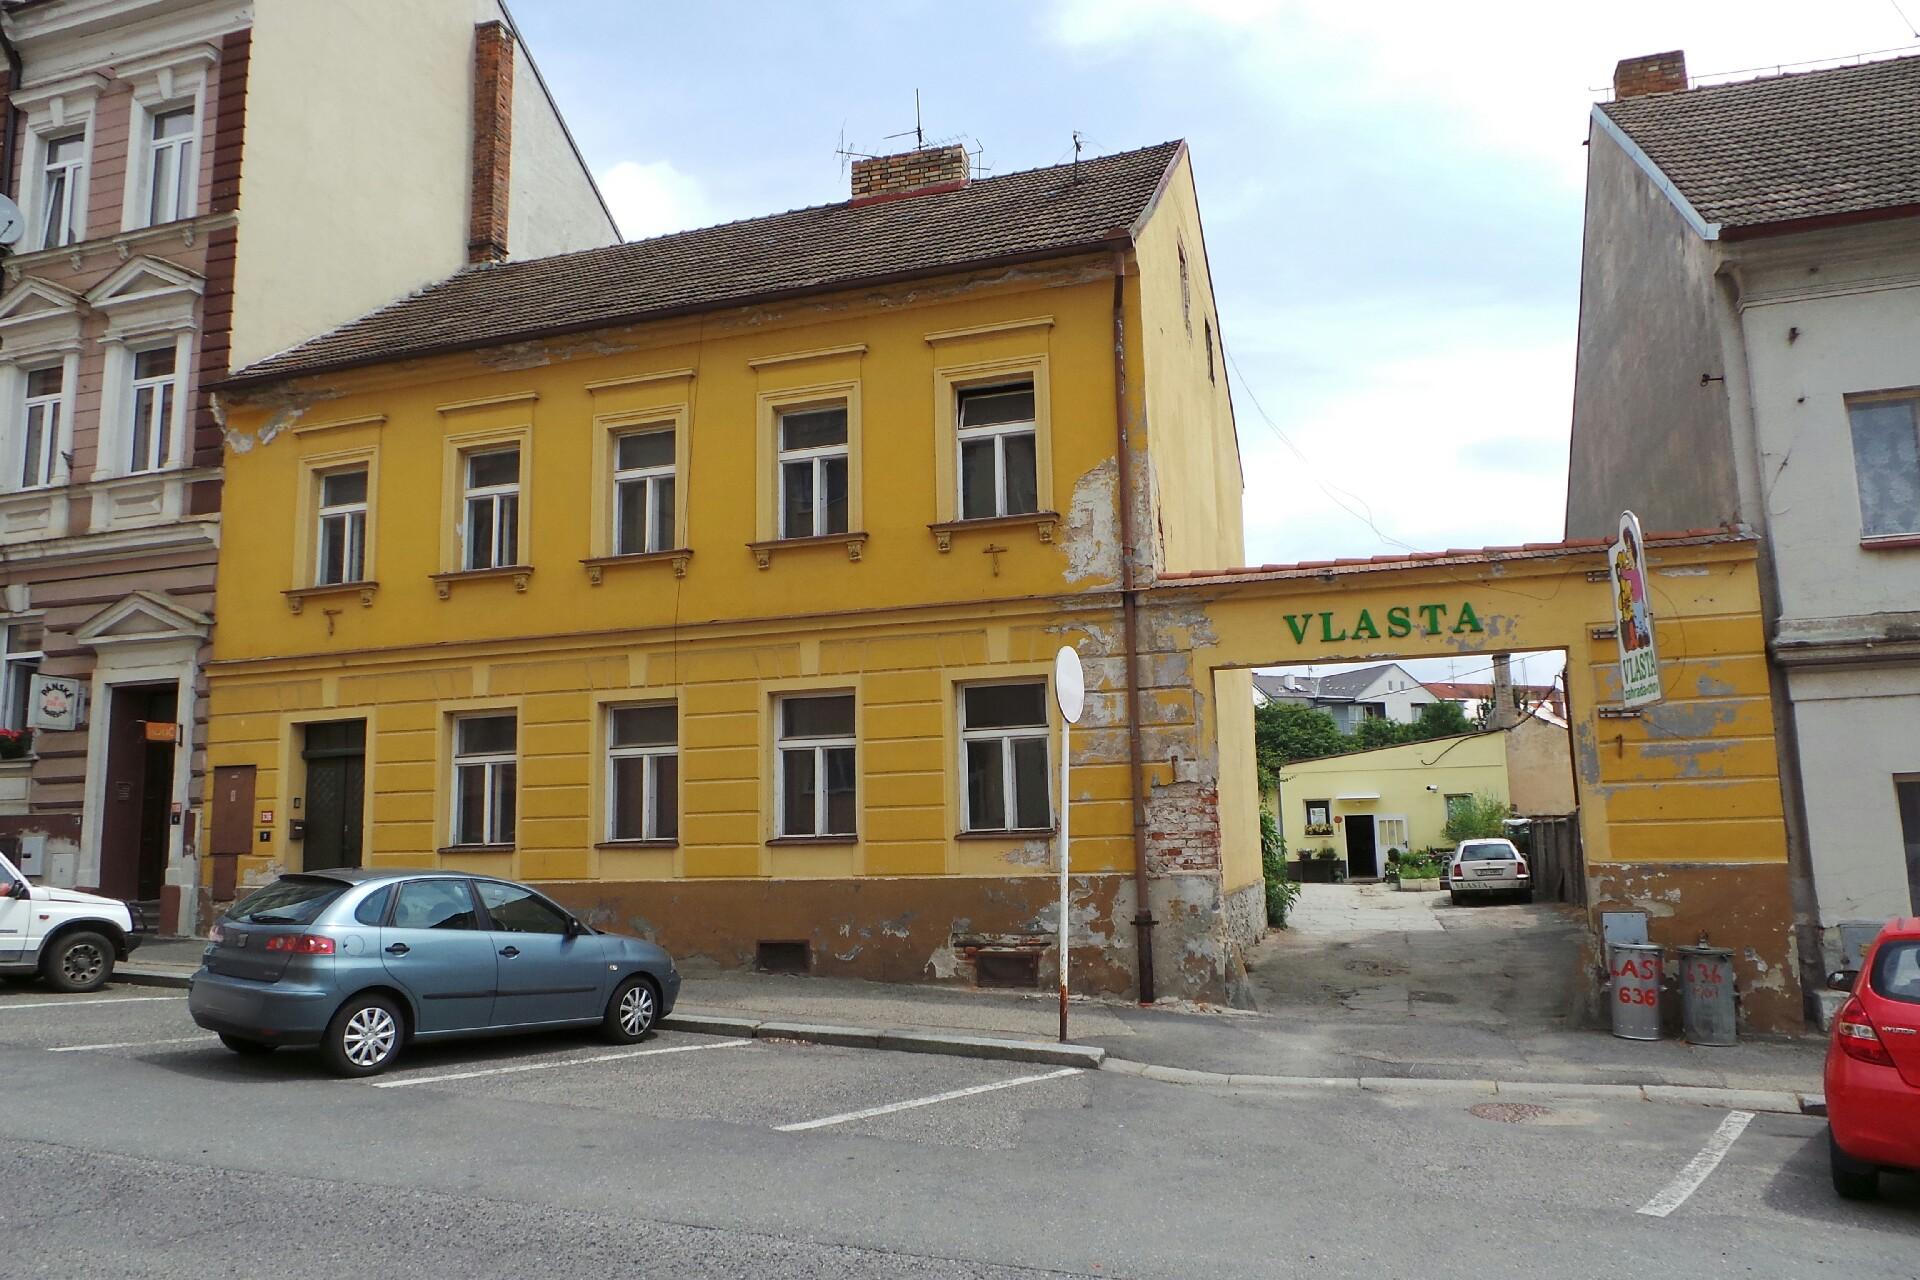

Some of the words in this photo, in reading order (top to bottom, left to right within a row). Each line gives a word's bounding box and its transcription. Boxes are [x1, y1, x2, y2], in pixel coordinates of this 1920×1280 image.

[1283, 602, 1484, 644] VLASTA
[1623, 649, 1657, 684] VLASTA
[1619, 986, 1656, 1007] 636
